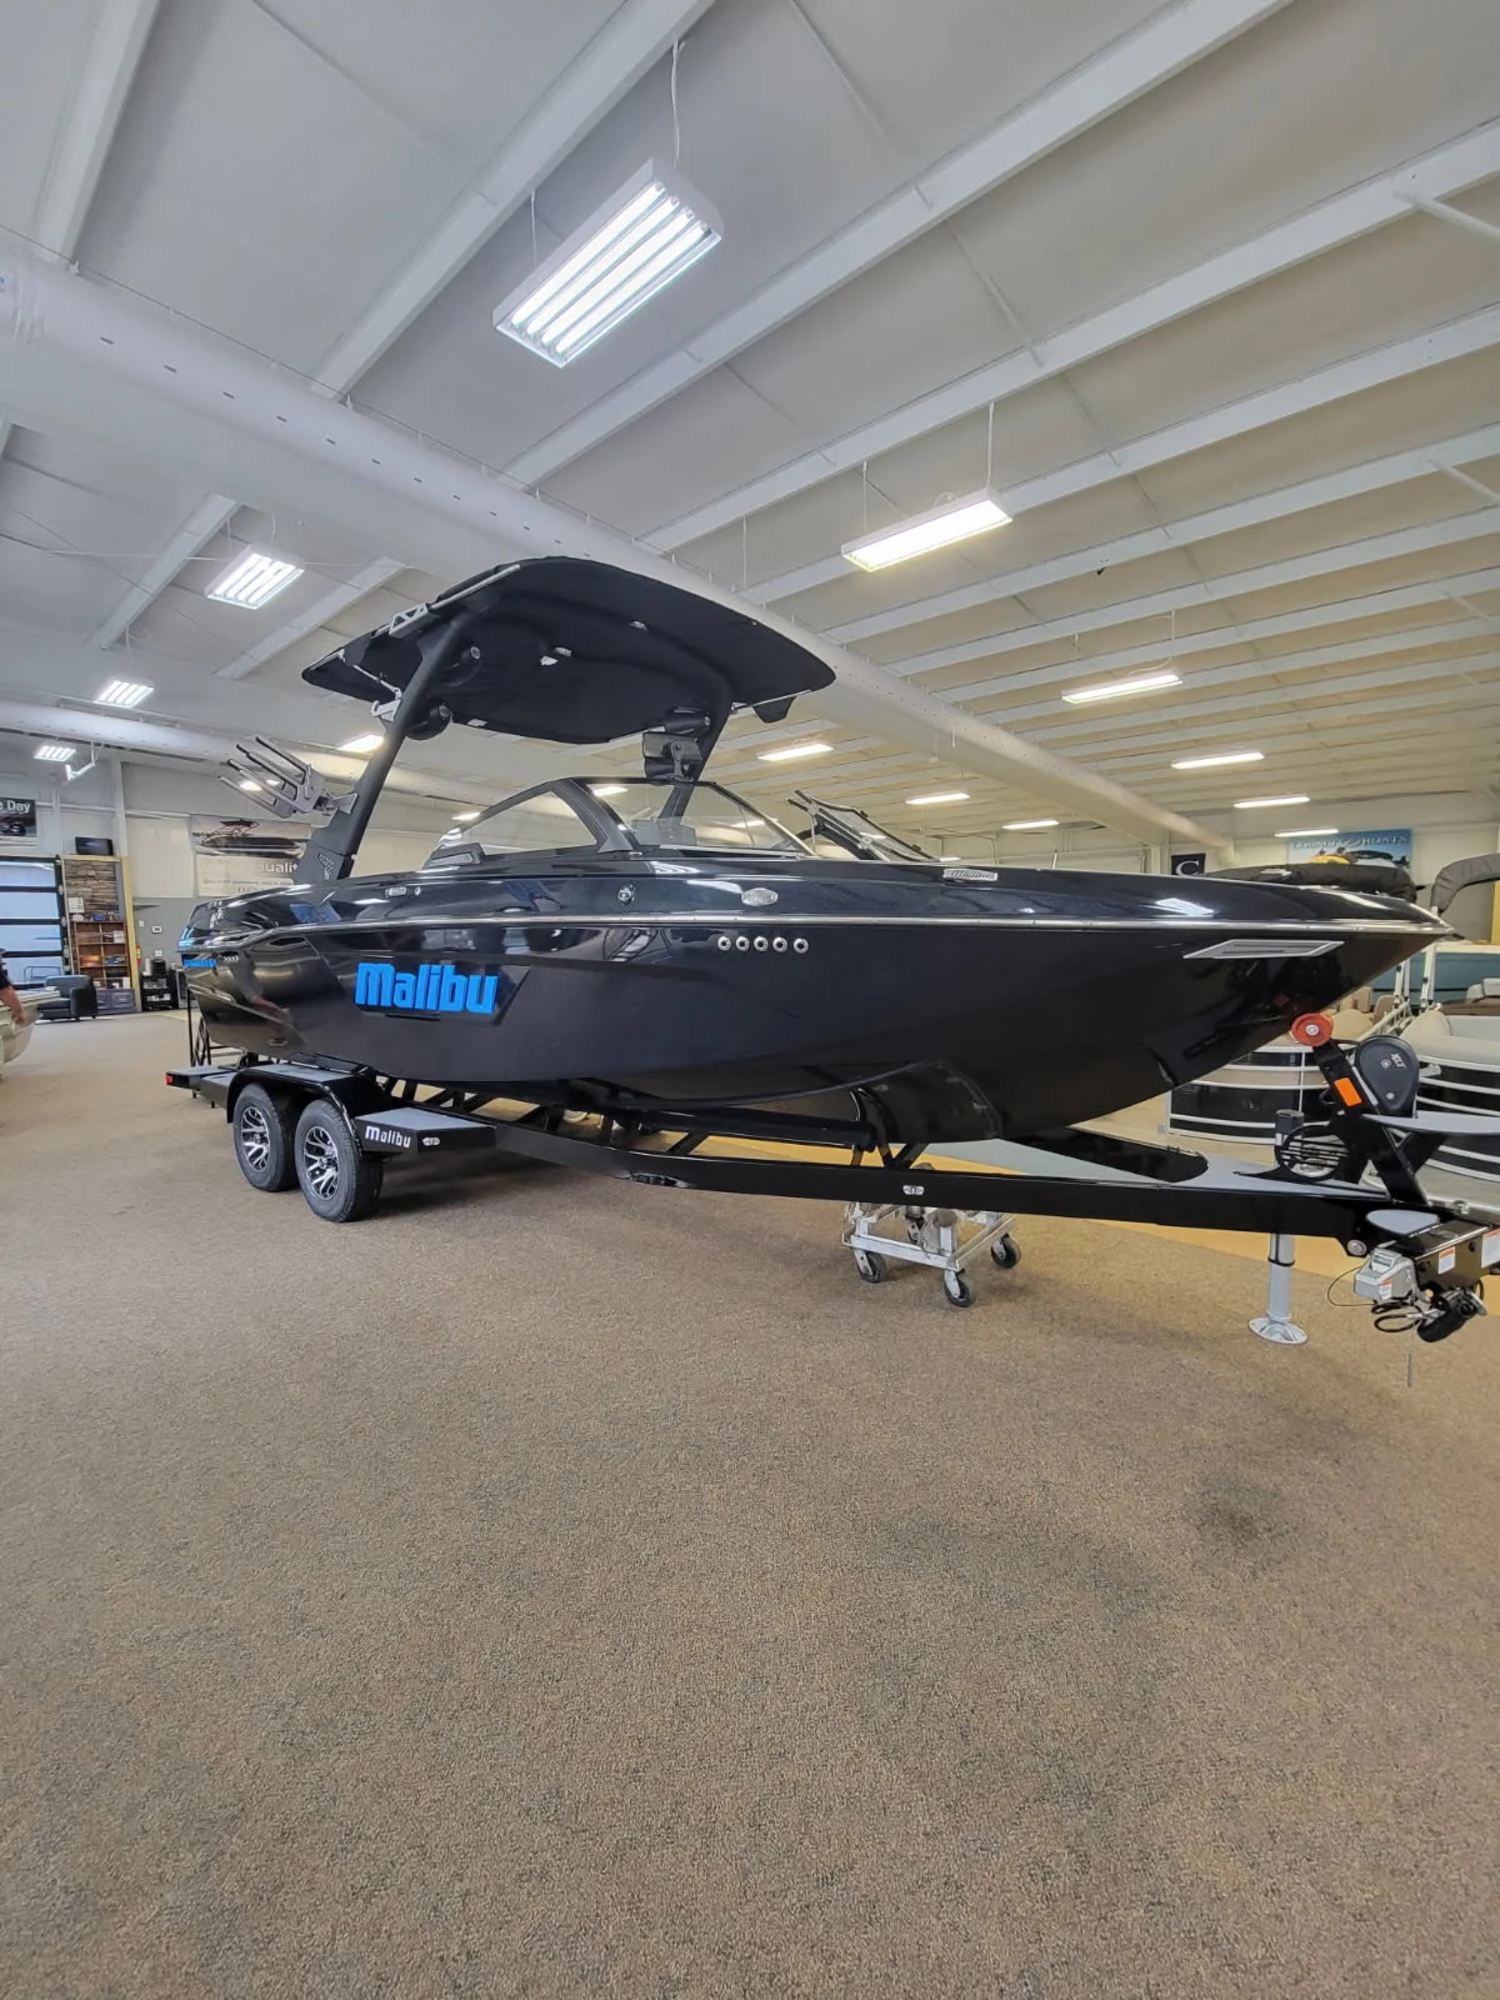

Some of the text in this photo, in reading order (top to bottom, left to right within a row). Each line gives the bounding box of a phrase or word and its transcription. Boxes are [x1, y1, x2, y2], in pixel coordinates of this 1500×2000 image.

[7, 800, 31, 813] Day
[355, 963, 498, 1014] Malibu
[365, 1126, 411, 1148] Malibu
